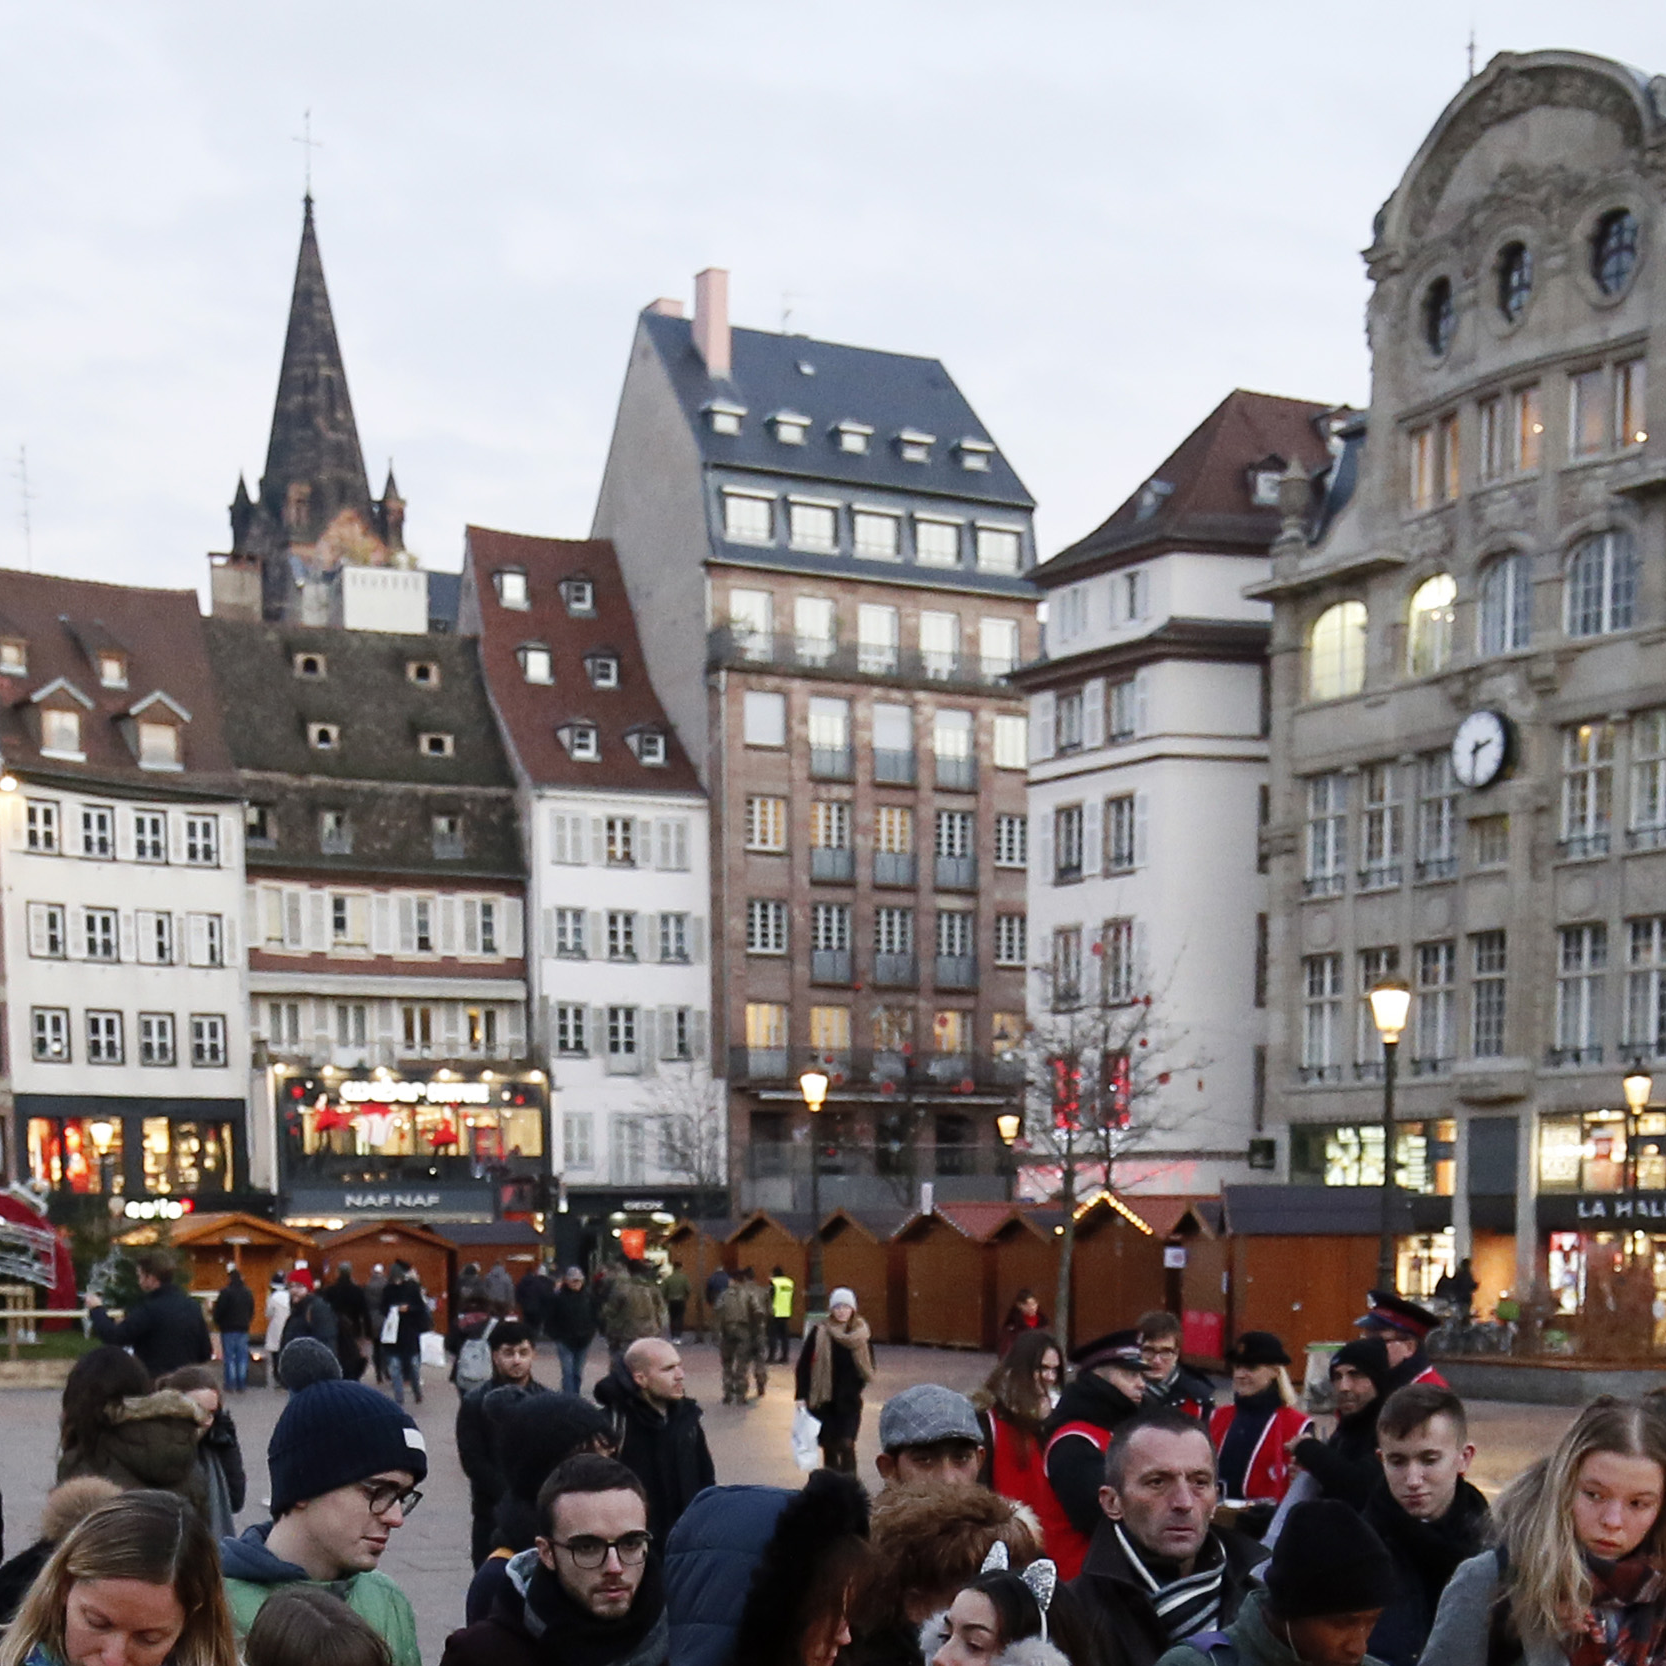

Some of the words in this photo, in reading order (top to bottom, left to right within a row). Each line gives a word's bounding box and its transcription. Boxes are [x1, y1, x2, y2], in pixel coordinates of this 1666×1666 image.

[345, 1193, 391, 1208] NAF
[395, 1193, 440, 1208] NAF
[1577, 1200, 1607, 1218] LA
